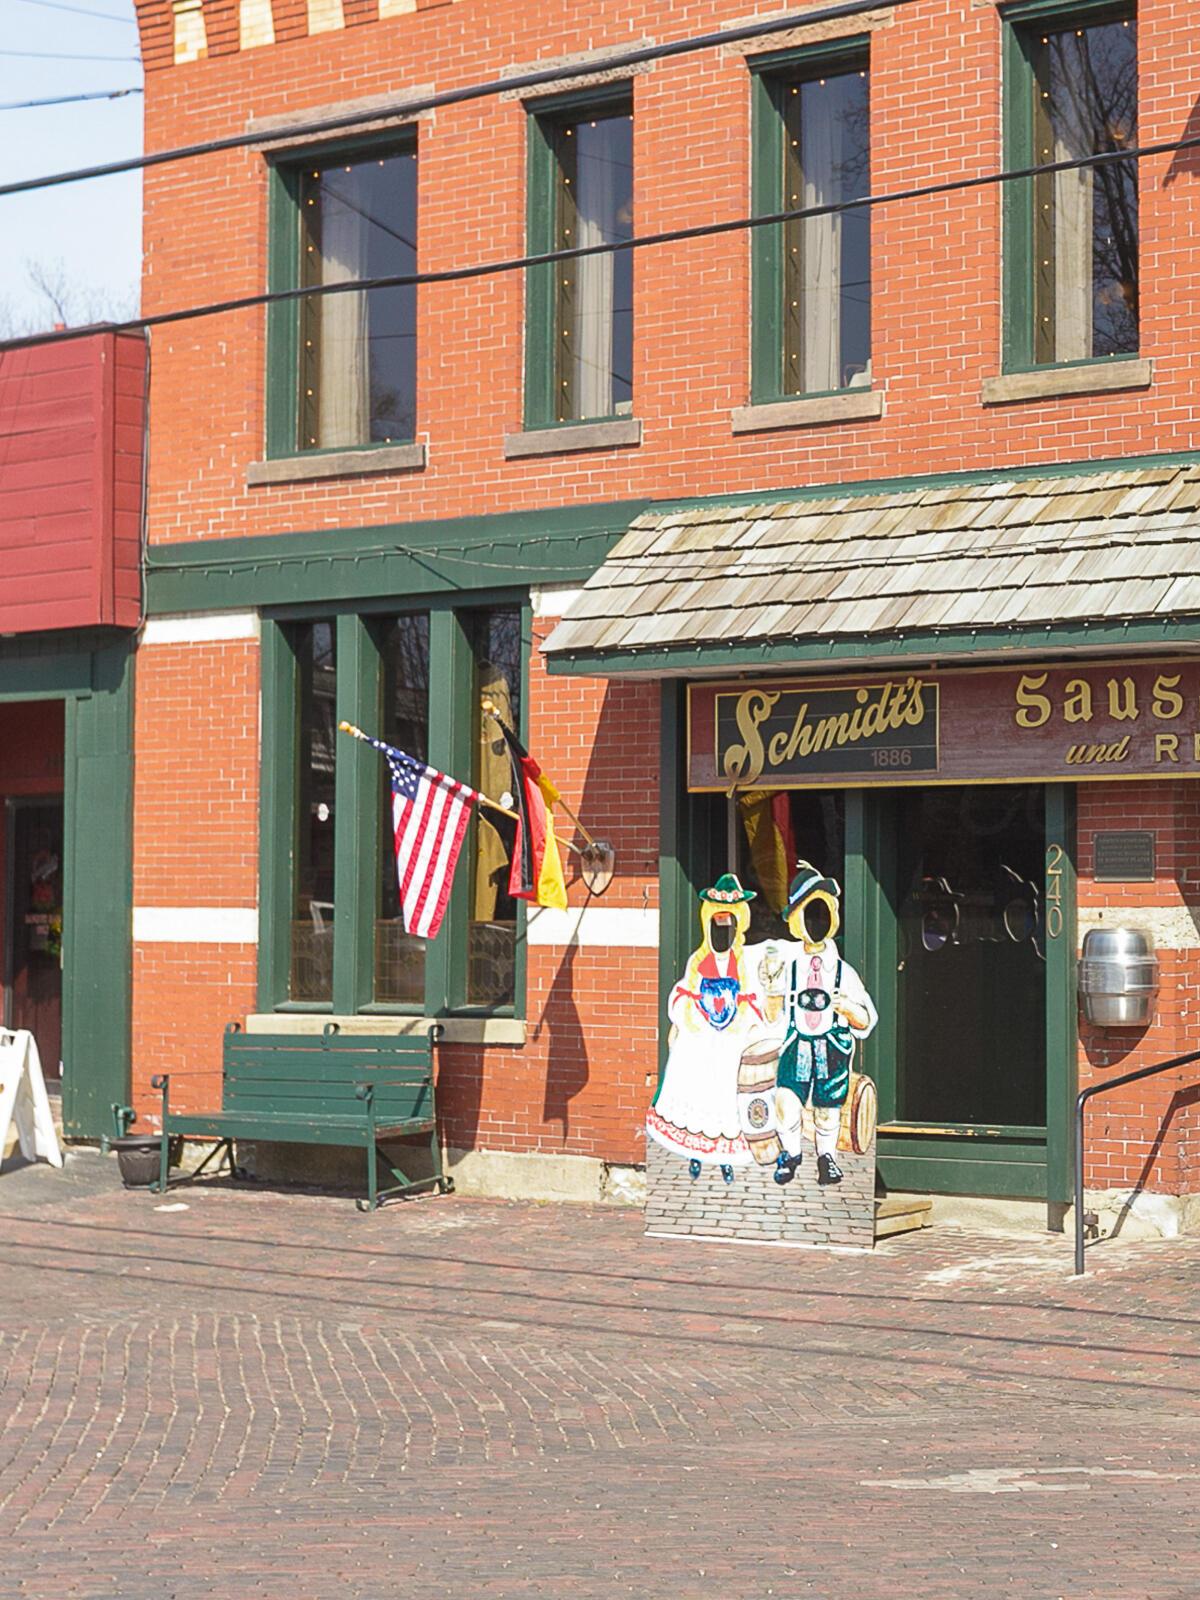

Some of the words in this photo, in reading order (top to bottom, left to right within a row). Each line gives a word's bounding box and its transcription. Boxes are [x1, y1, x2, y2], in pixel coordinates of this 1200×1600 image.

[723, 676, 925, 798] Schmidt's
[870, 749, 912, 768] 1886
[1064, 735, 1131, 765] und
[1046, 843, 1063, 938] 240
